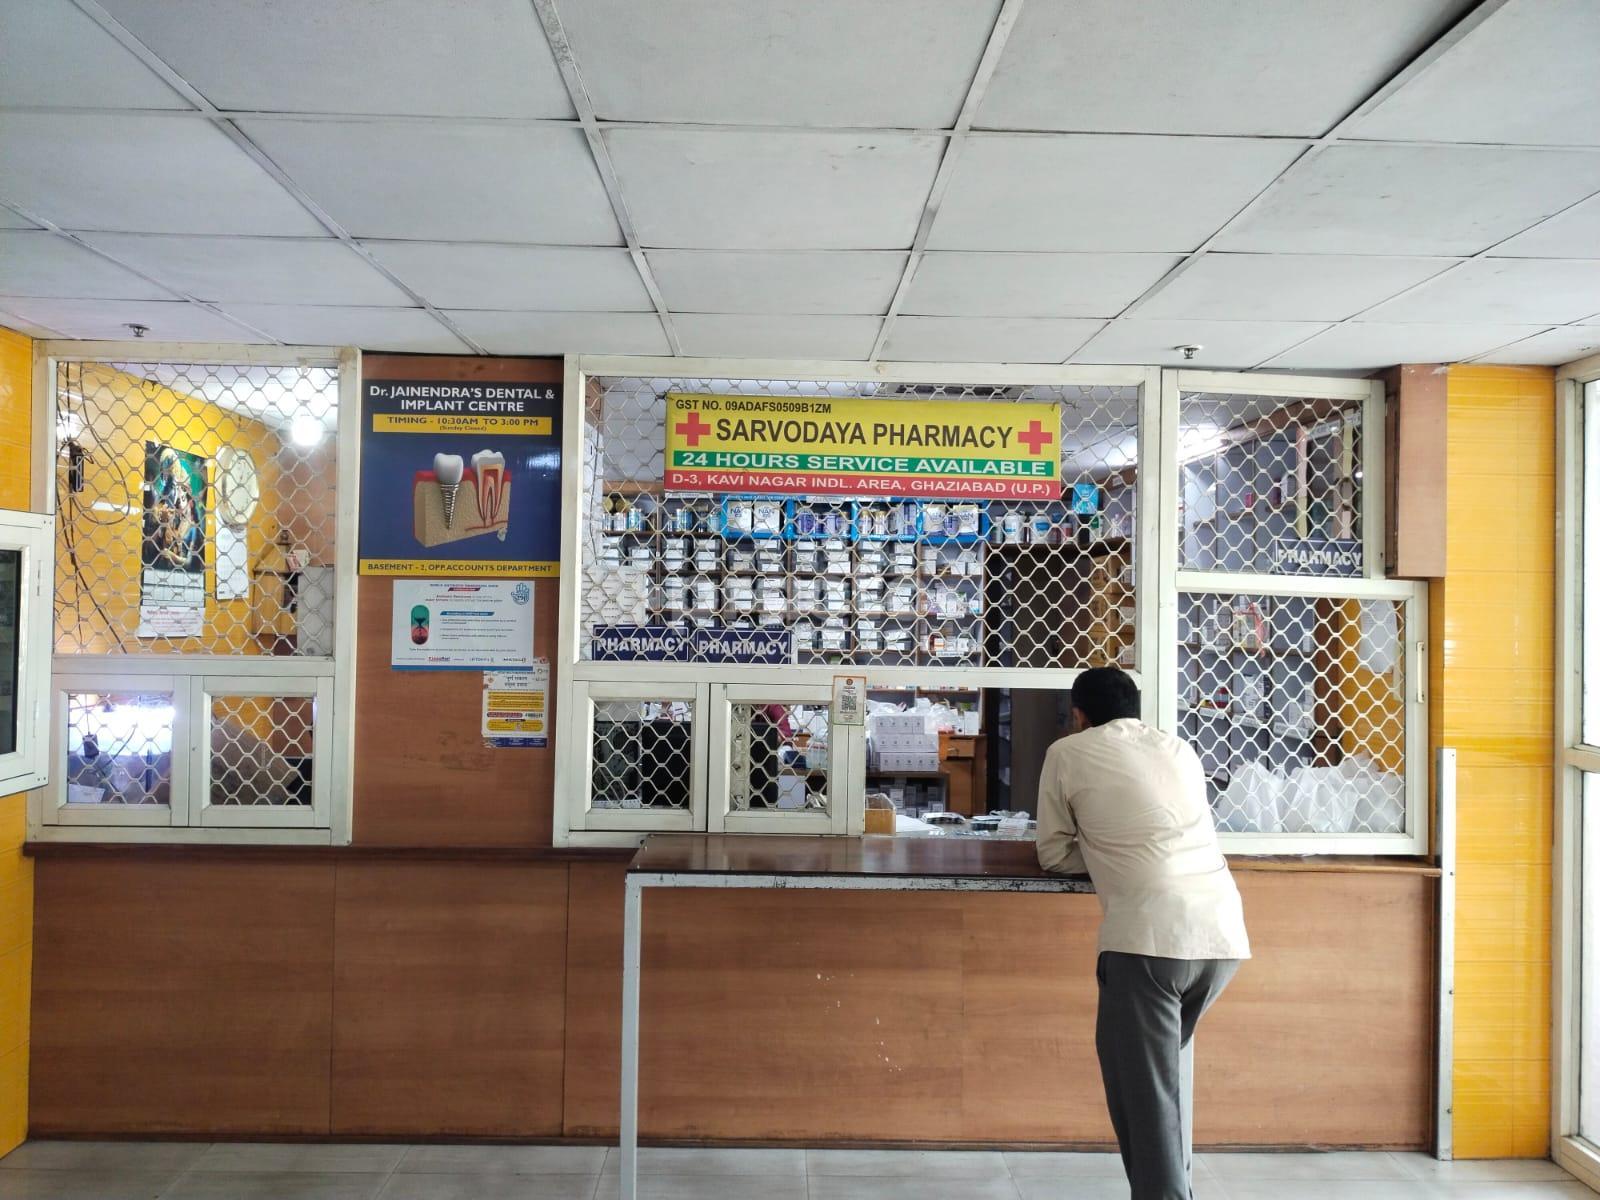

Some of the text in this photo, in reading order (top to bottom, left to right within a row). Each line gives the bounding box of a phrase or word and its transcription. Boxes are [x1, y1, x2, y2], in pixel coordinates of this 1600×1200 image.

[370, 386, 555, 399] Dr. JAINENDRA'S DENTAL &
[400, 400, 524, 412] IMPLANT CENTRE
[676, 400, 832, 413] GST NO. 09ADAFS0509B1ZM
[387, 416, 427, 424] TIMING
[716, 418, 1014, 448] SARVODAYA PHARMACY
[682, 453, 1046, 475] 24 HOURS SERVICE AVAILABLE
[708, 474, 744, 486] KAVI
[750, 476, 806, 487] NAGAR
[812, 477, 852, 488] INDL.
[857, 479, 906, 491] AREA,
[910, 480, 1006, 492] GHAZIABAD
[1011, 482, 1050, 496] (U.P.)
[1278, 550, 1362, 566] PHARMACY
[596, 638, 788, 656] PHARMACY PHARMACY
